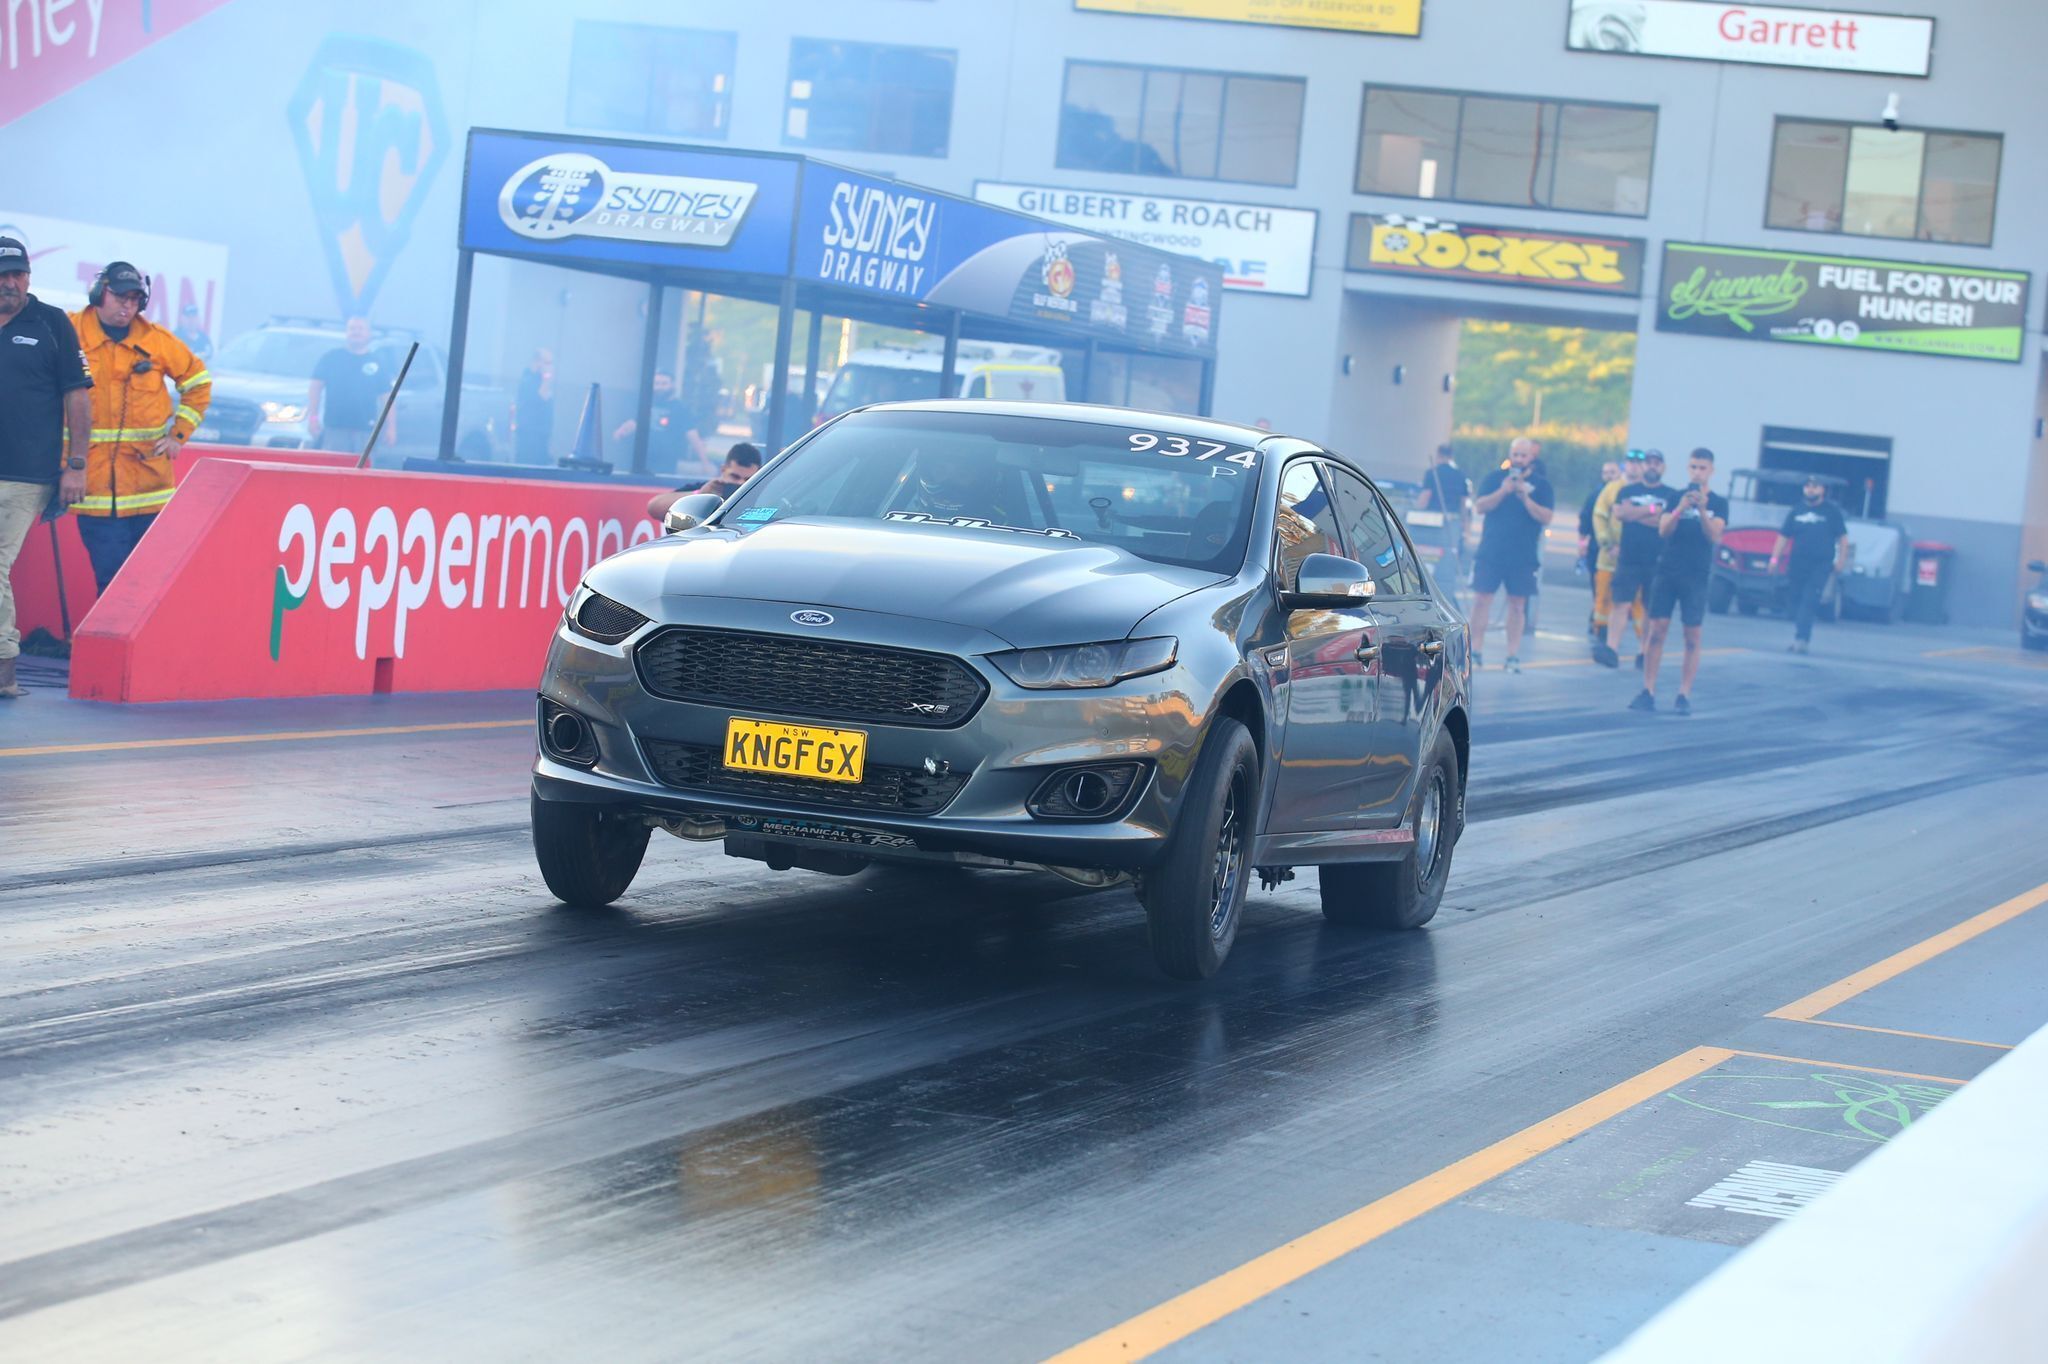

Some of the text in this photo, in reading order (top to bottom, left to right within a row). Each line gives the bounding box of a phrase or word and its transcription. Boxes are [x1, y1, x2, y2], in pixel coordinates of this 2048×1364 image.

[0, 0, 103, 69] ney
[1718, 9, 1859, 51] Garrett
[605, 185, 743, 219] SYDNEY
[1018, 190, 1272, 232] GILBERT & ROACH
[596, 212, 729, 235] DRAGWAY
[823, 182, 936, 261] SYDNEY
[1090, 227, 1202, 247] NTINGWOOD
[820, 248, 924, 295] DRAGWAY
[1818, 265, 2021, 305] FUEL FOR YOUR
[77, 261, 215, 335] TAN
[1858, 296, 1974, 327] HUNGER!
[1128, 433, 1257, 469] 9374
[1212, 466, 1238, 478] P
[269, 503, 666, 662] peppermon
[799, 611, 824, 624] Ford
[783, 727, 810, 737] NSW
[731, 731, 858, 777] KNGFGX
[763, 822, 848, 838] MECHANICAL
